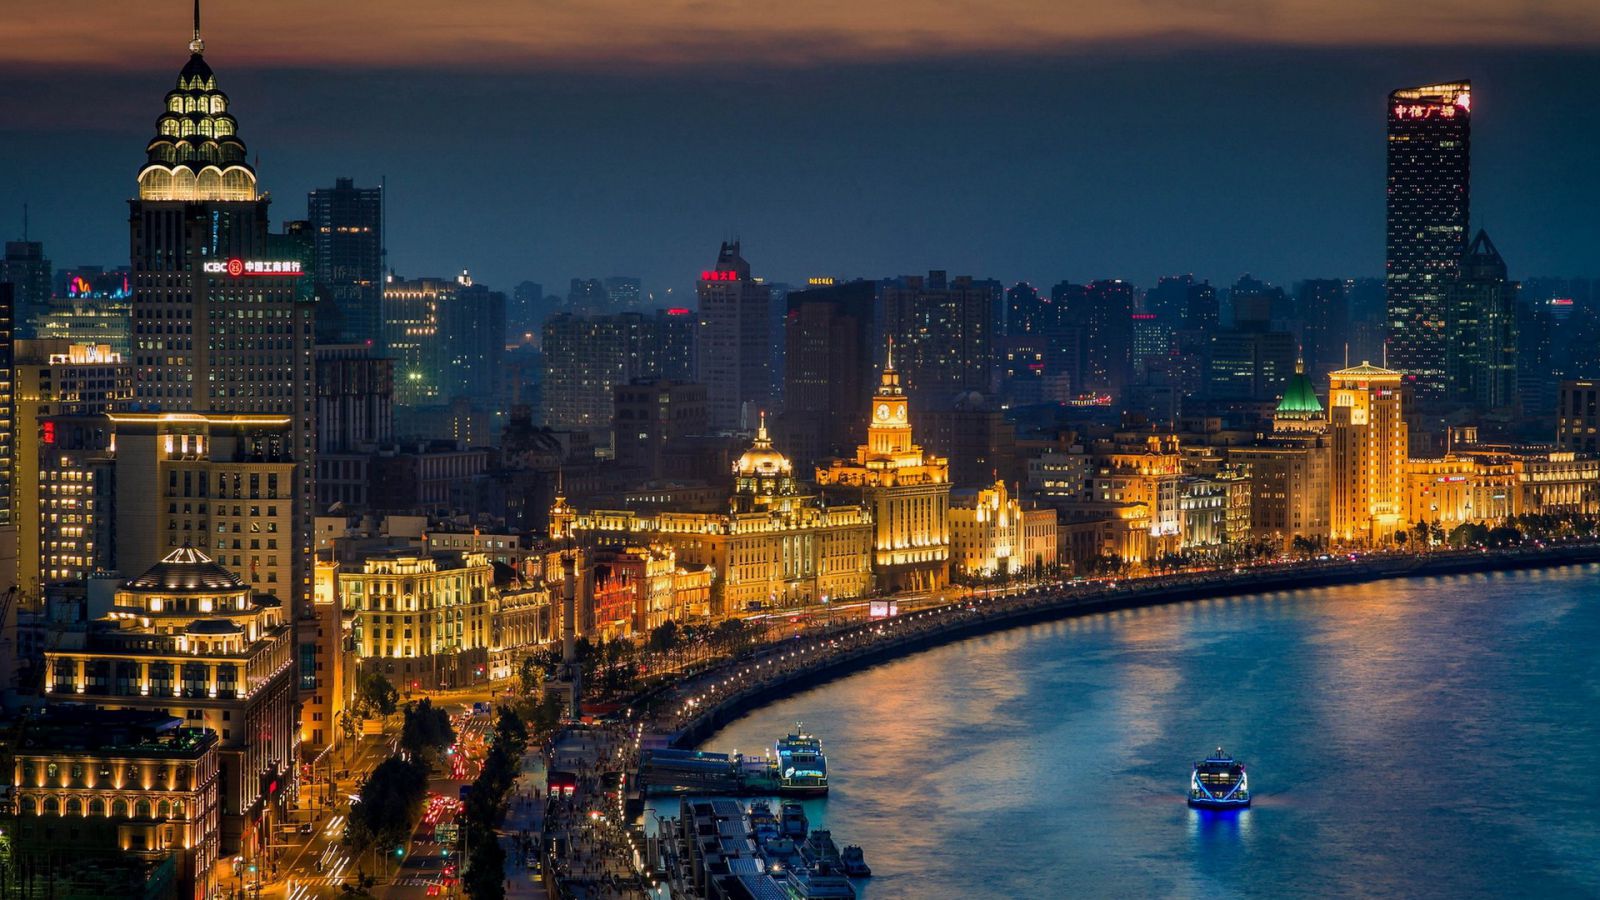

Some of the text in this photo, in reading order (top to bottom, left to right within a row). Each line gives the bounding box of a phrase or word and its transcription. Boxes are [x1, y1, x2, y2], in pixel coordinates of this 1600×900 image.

[203, 262, 227, 273] ICBC
[244, 261, 301, 273] 中国工商银行
